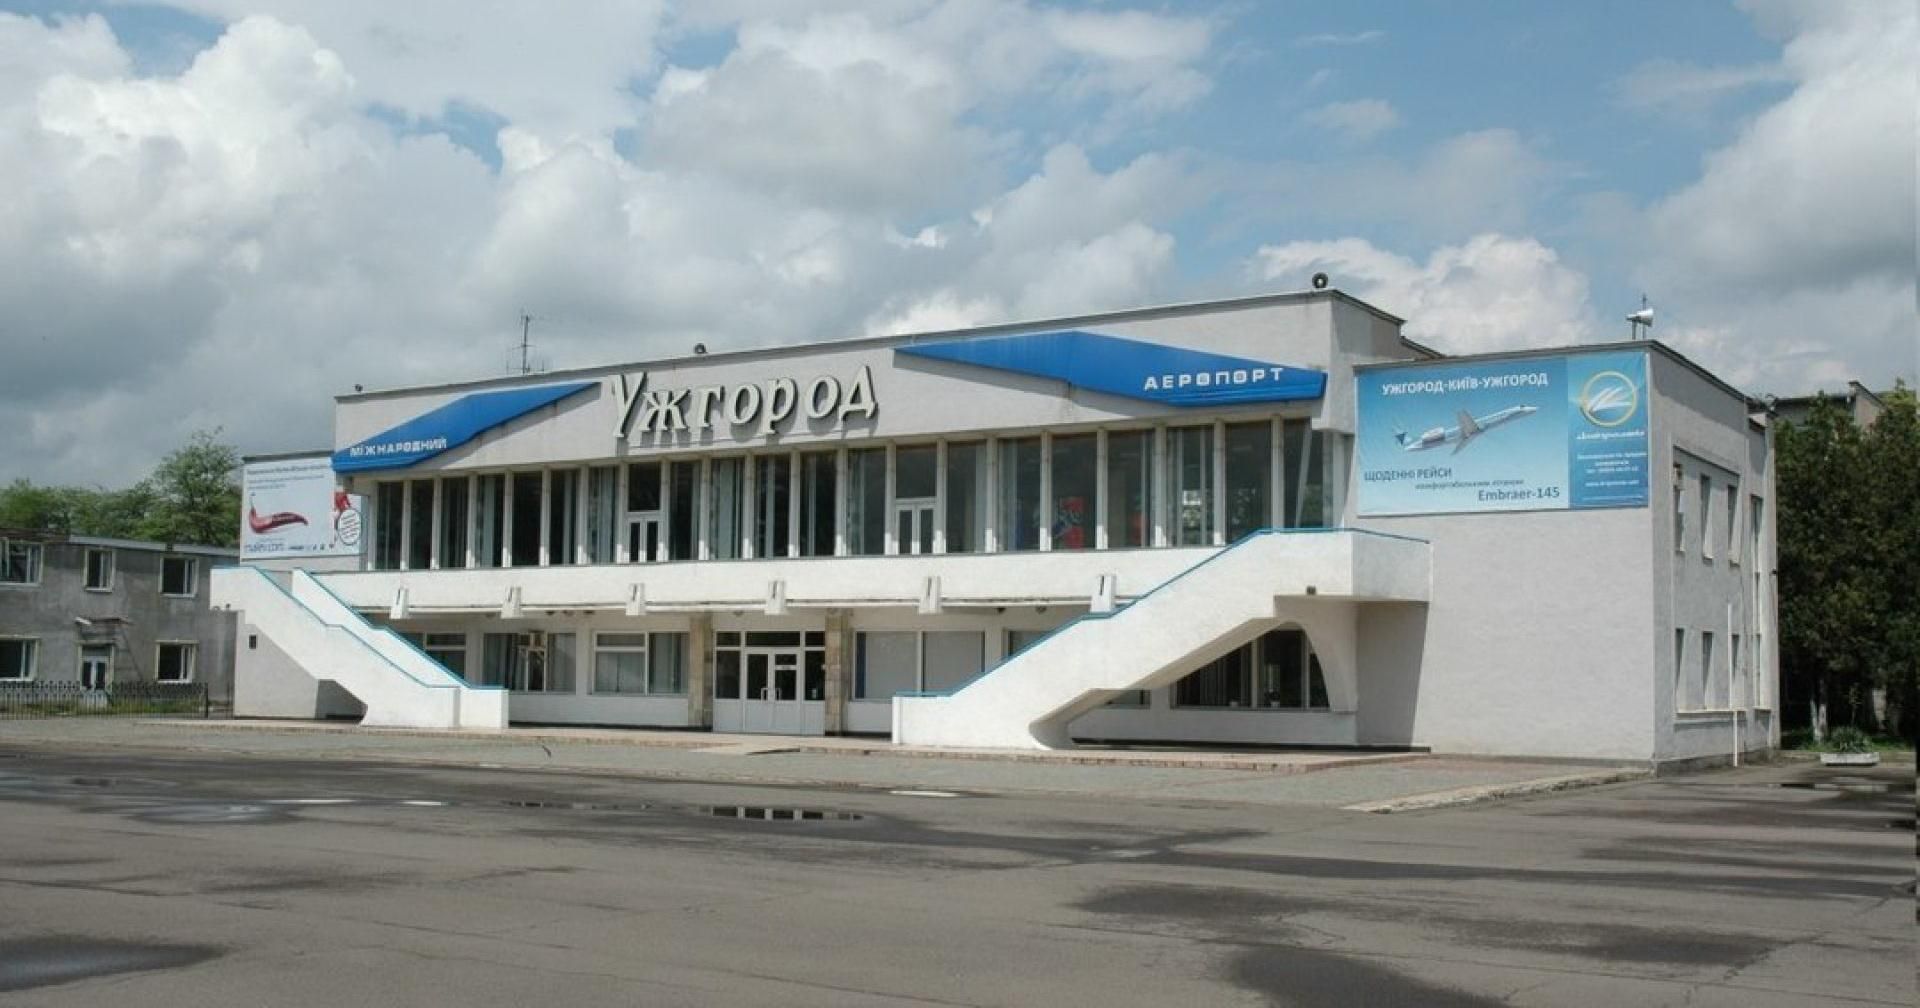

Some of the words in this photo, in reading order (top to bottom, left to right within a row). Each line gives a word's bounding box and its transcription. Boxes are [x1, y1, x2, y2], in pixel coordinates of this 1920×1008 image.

[1144, 367, 1283, 391] АЕРОПОРТ
[1382, 372, 1549, 396] УЖГОРОД-КИЇВ-УЖГОРОД
[607, 366, 879, 438] Ужгород
[349, 436, 447, 457] МІЖНАРОДНИЙ
[1417, 465, 1452, 479] РЕЙСИ
[1478, 486, 1560, 501] Embraer-145
